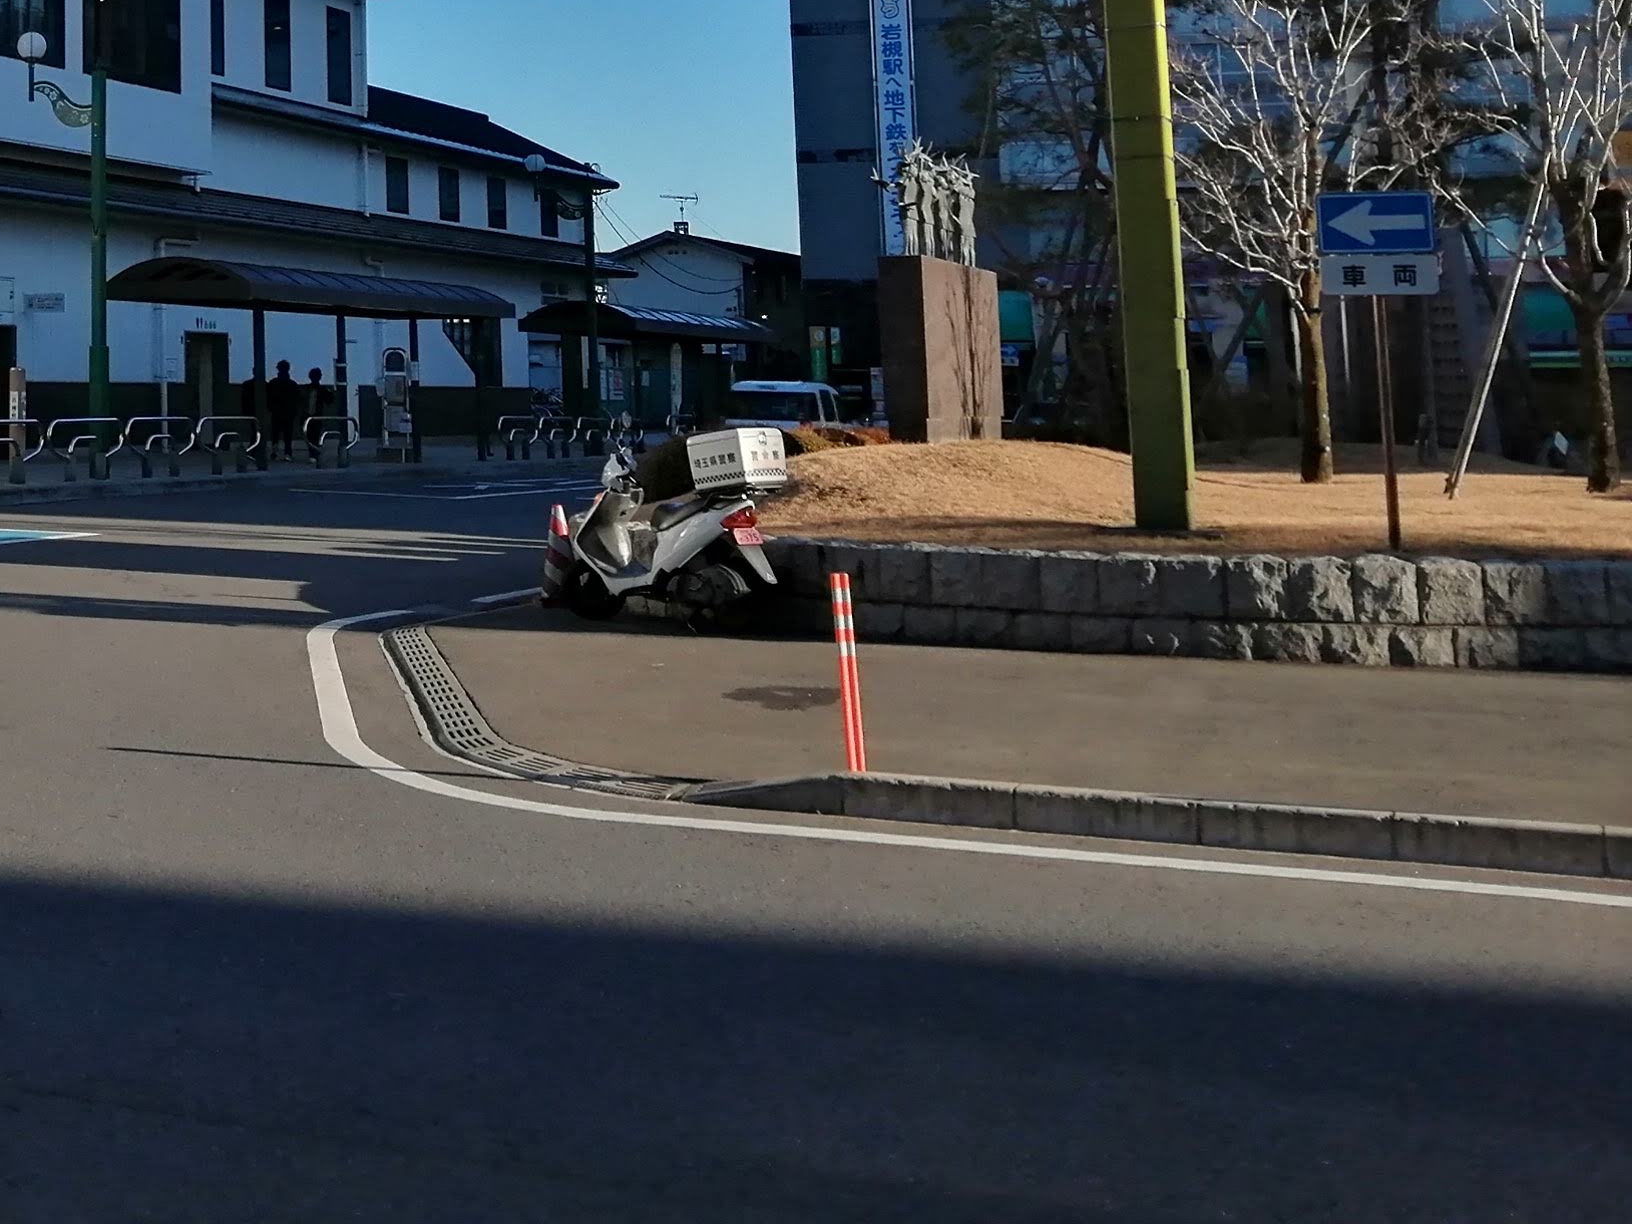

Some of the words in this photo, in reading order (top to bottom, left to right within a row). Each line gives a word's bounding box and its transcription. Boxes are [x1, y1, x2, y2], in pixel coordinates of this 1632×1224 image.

[1342, 264, 1417, 287] 車両
[694, 452, 736, 469] 埼玉県警察
